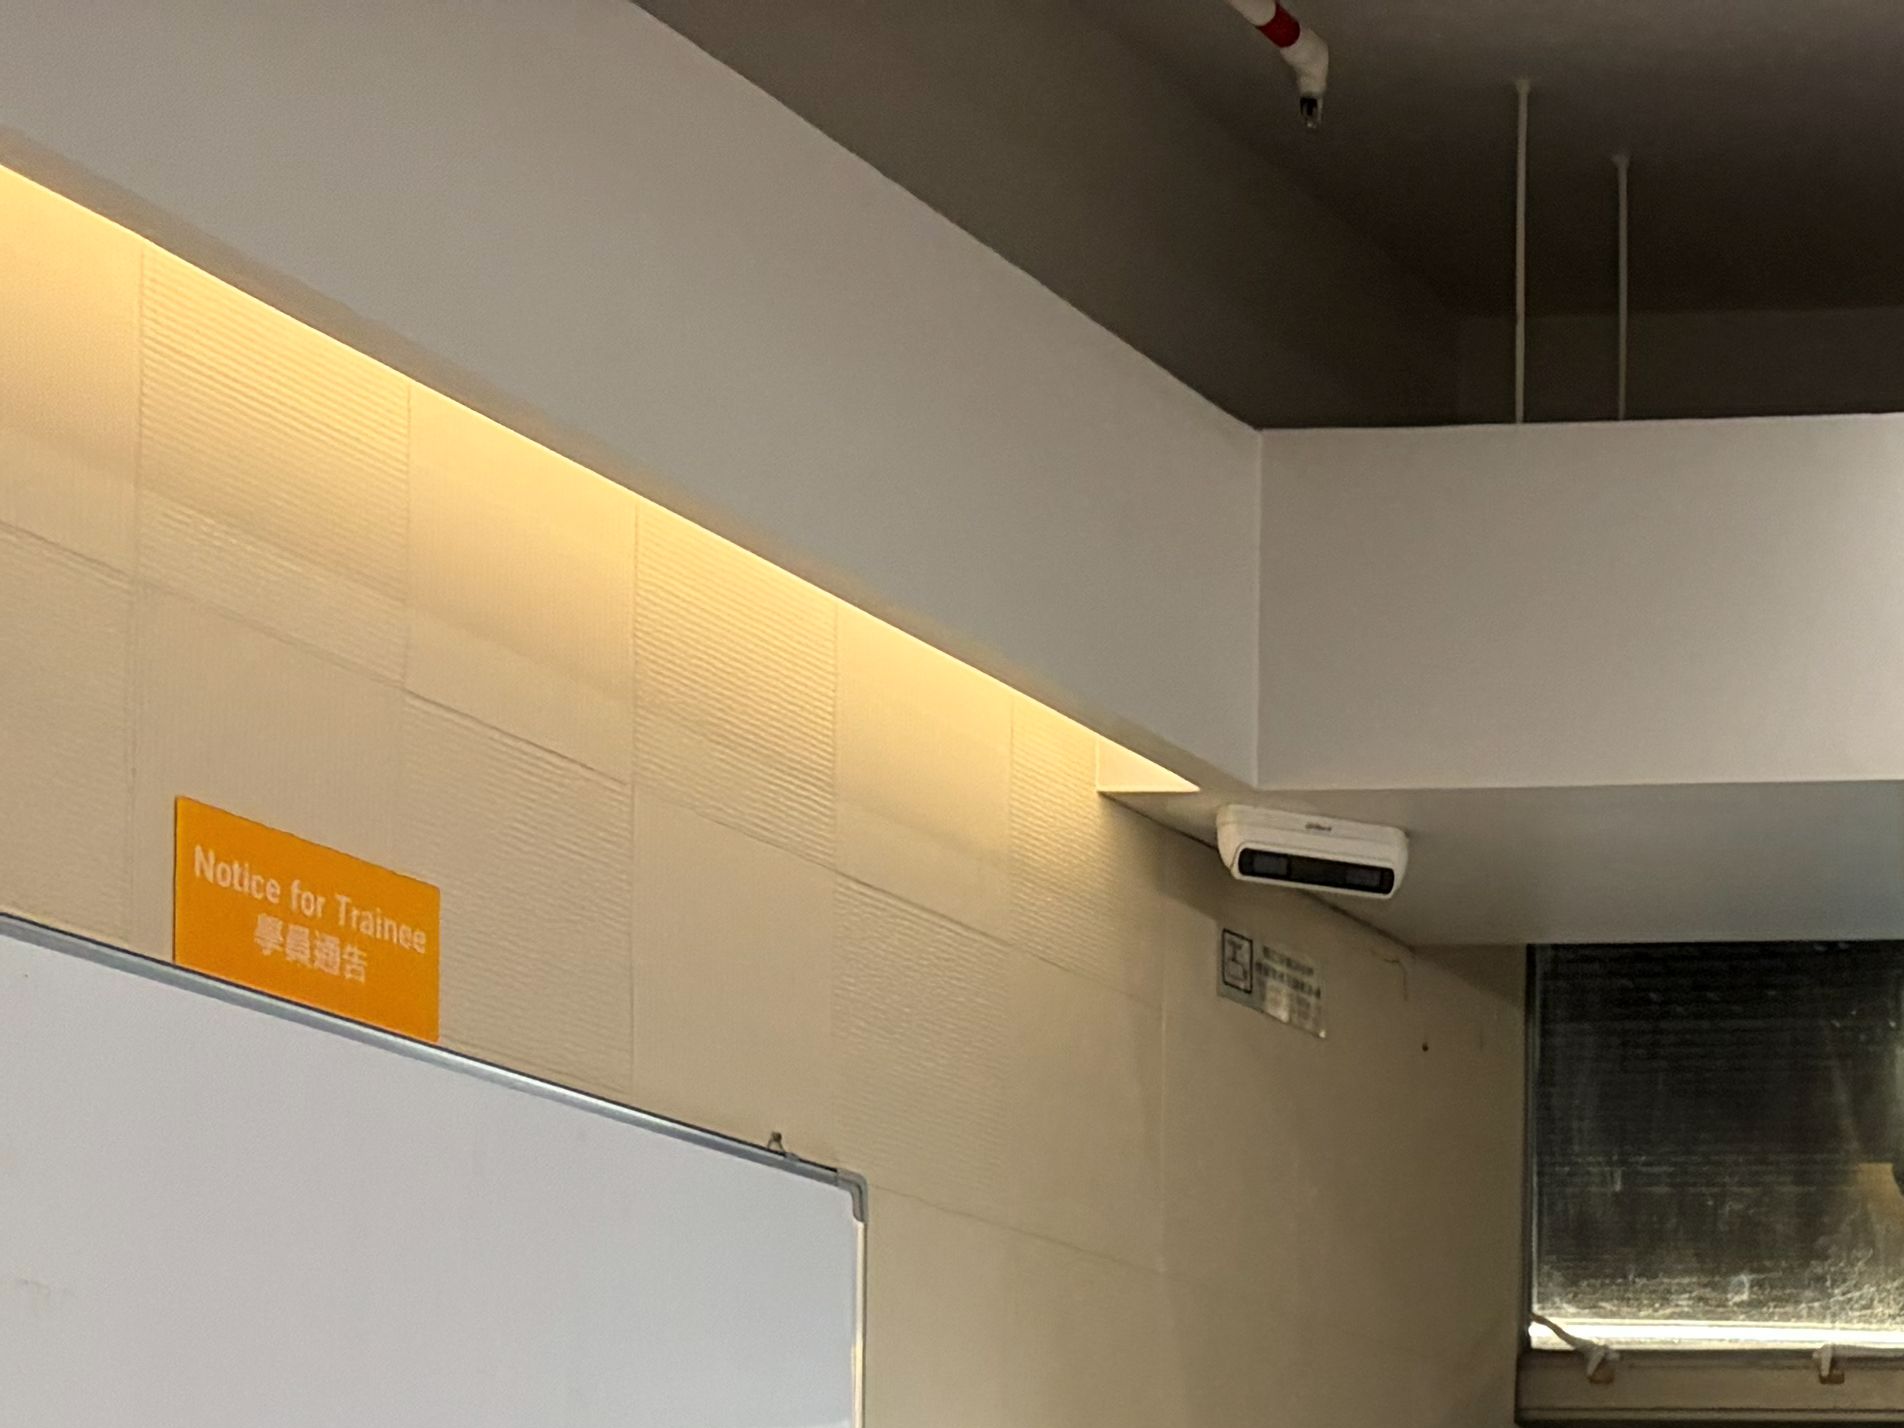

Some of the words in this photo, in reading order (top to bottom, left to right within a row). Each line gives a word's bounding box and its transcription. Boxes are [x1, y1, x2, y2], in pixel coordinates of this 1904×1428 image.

[195, 846, 281, 904] Notice
[291, 880, 326, 919] for
[335, 894, 426, 954] Trainee
[255, 914, 368, 984] 學員通告
